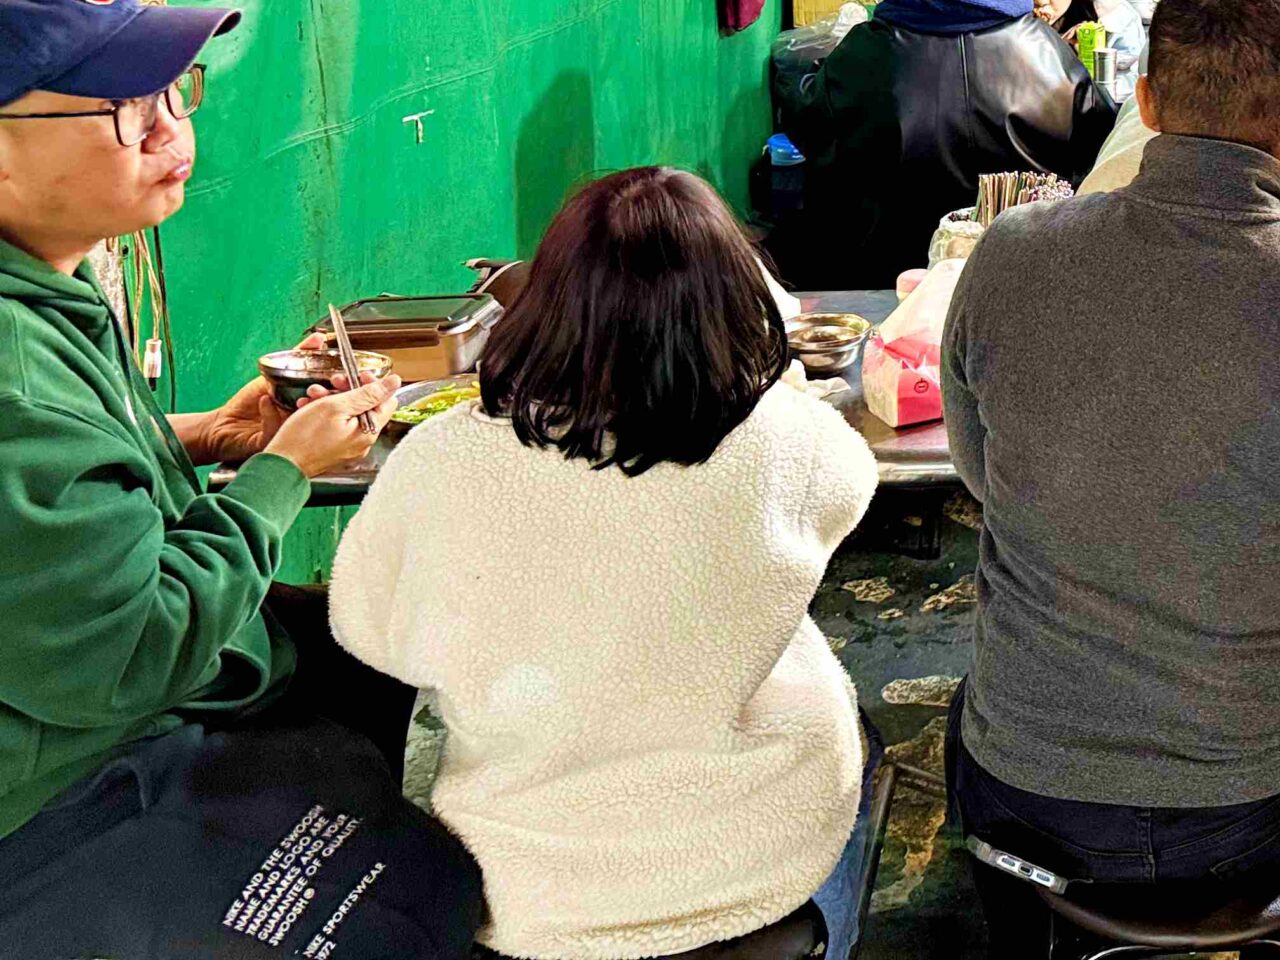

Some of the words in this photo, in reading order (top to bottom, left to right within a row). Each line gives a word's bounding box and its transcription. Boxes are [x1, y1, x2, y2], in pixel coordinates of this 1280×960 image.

[222, 899, 245, 926] NIKE
[242, 872, 264, 901] AND
[261, 847, 284, 871] THE
[280, 804, 324, 849] SWOOSH
[234, 897, 262, 932] NAME
[258, 871, 281, 898] AND
[279, 836, 311, 870] LOGO
[310, 816, 330, 836] ARE
[245, 866, 301, 935] TRADEMARKS
[300, 840, 324, 865] AND
[321, 814, 349, 838] YOUR
[258, 877, 308, 940] GUARANTEE
[305, 858, 322, 876] OF
[303, 933, 326, 958] NIKE
[322, 862, 386, 934] SPORTSWEAR
